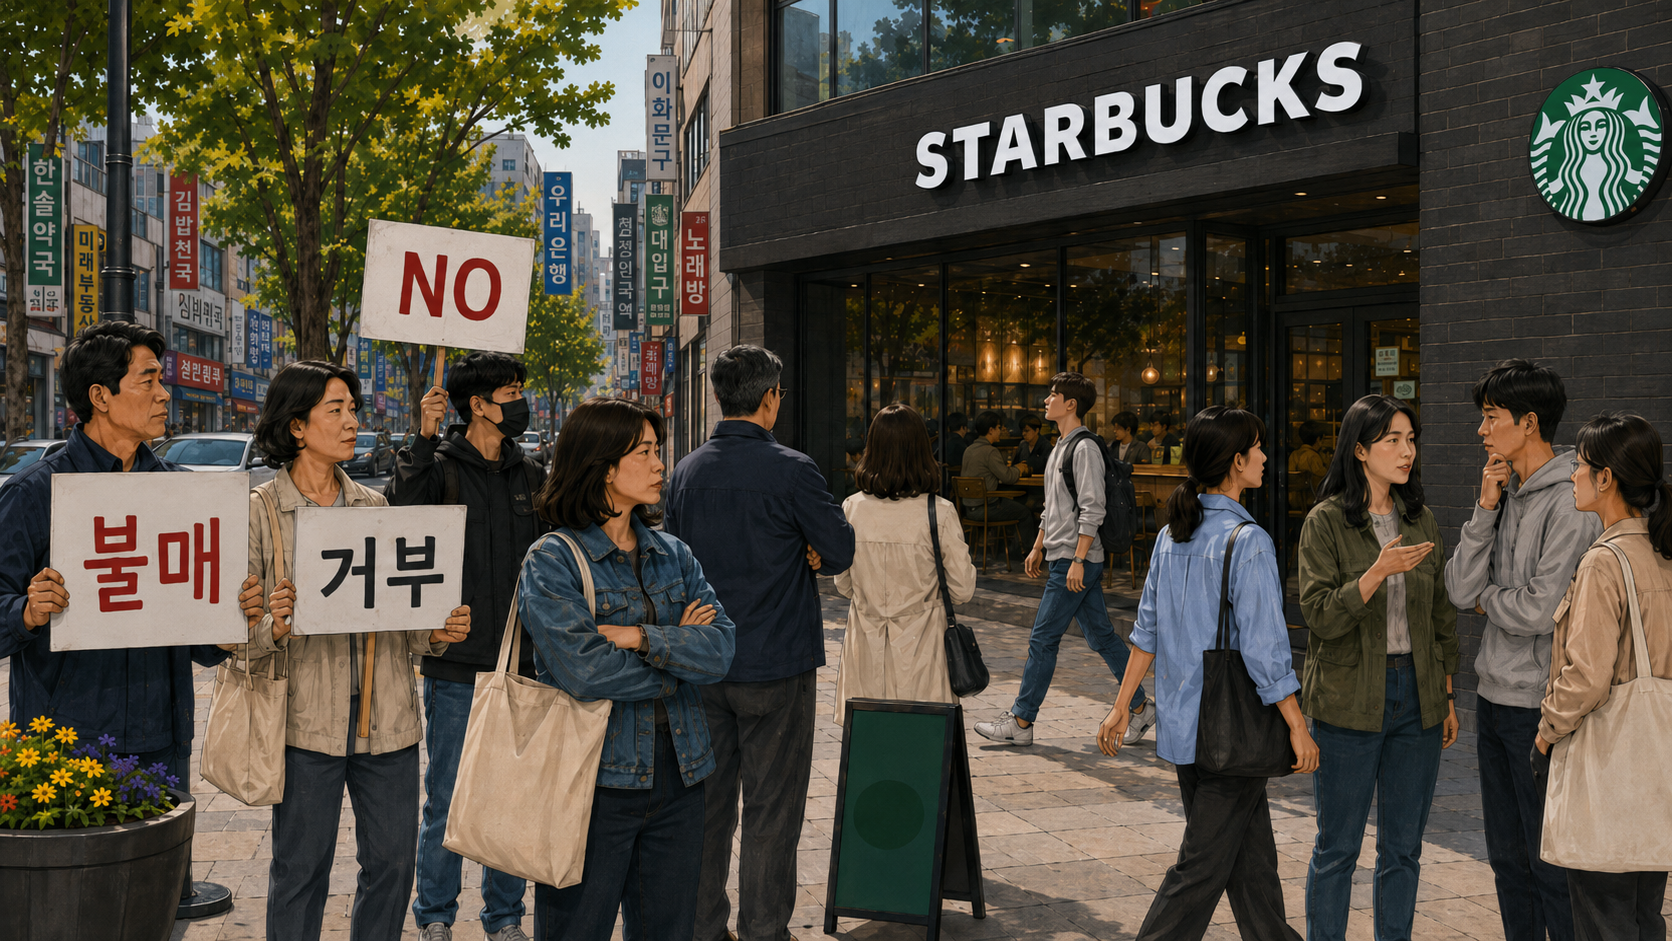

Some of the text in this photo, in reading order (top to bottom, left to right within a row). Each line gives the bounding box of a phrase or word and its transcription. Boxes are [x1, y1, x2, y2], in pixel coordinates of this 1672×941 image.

[652, 71, 673, 171] 이화문구
[914, 41, 1363, 190] STARBUCKS
[33, 158, 56, 277] 한솔약국
[175, 191, 193, 283] 김밥천국
[549, 185, 567, 285] 우리은행
[651, 229, 669, 299] 대입구
[399, 251, 502, 321] NO
[686, 228, 706, 305] 노래방
[83, 515, 220, 613] 불매
[320, 536, 444, 609] 거부
